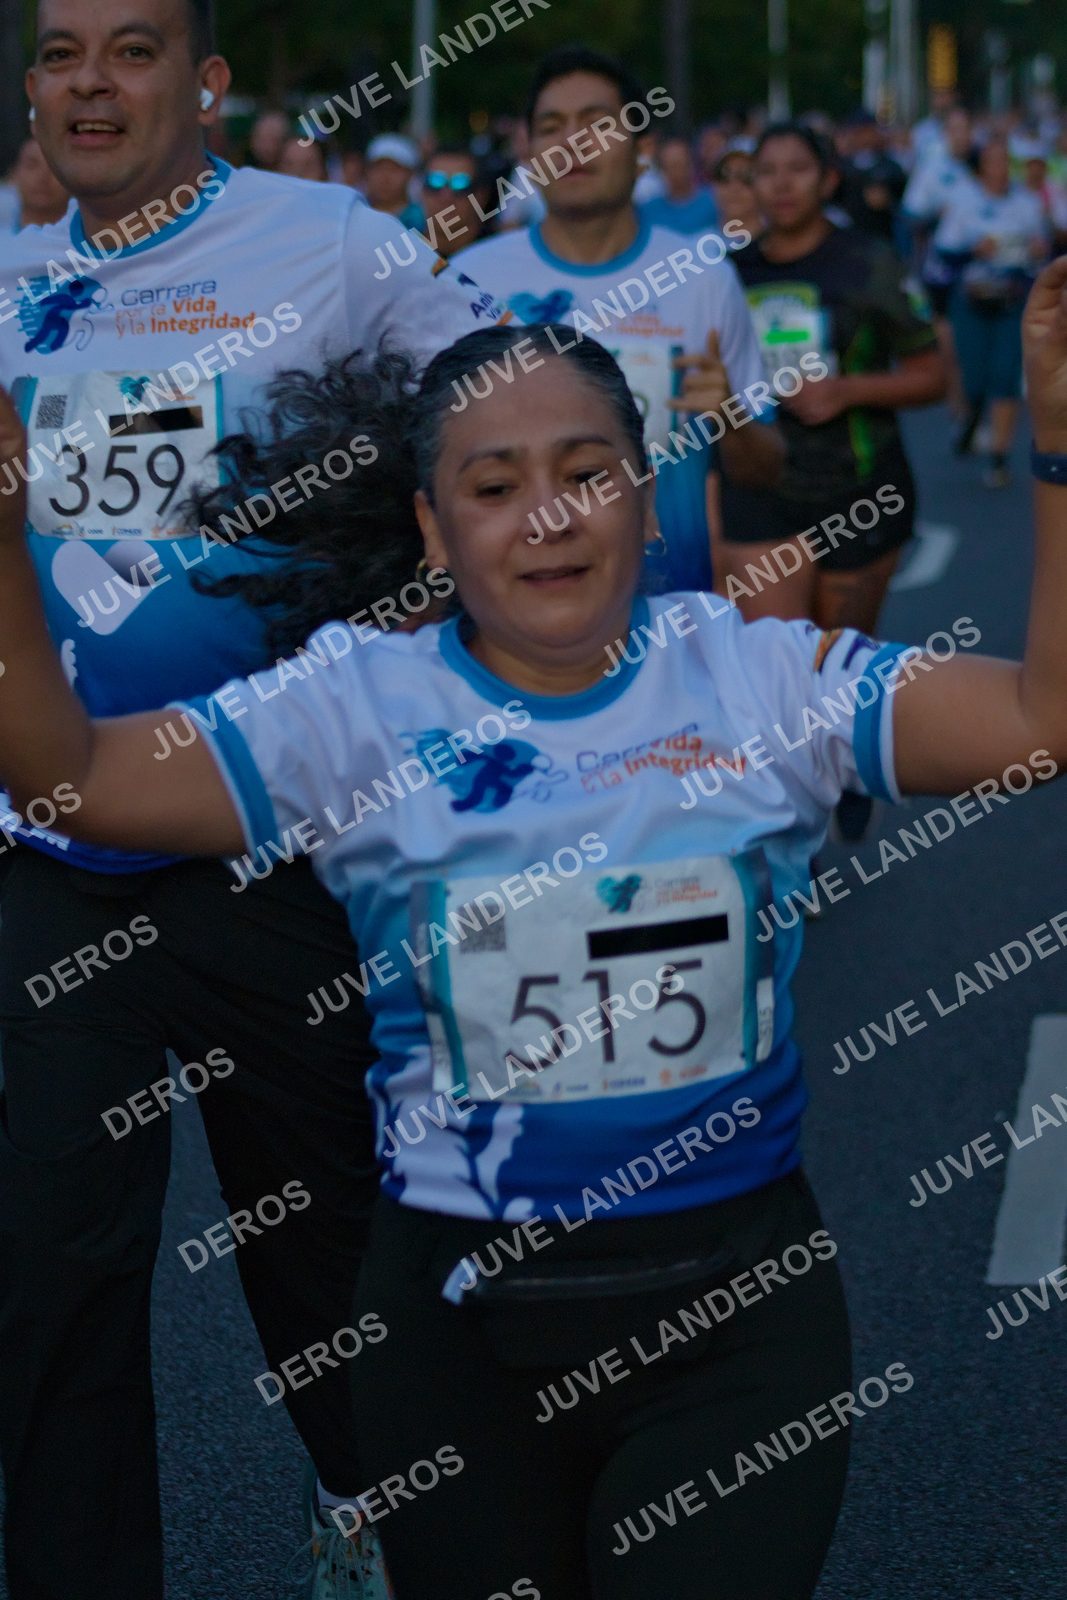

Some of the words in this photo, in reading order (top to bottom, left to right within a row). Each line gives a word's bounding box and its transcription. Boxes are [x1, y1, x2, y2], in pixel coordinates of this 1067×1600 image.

[151, 311, 257, 335] Integridad
[172, 296, 217, 314] Vida
[48, 443, 185, 517] 359
[505, 957, 706, 1072] 515
